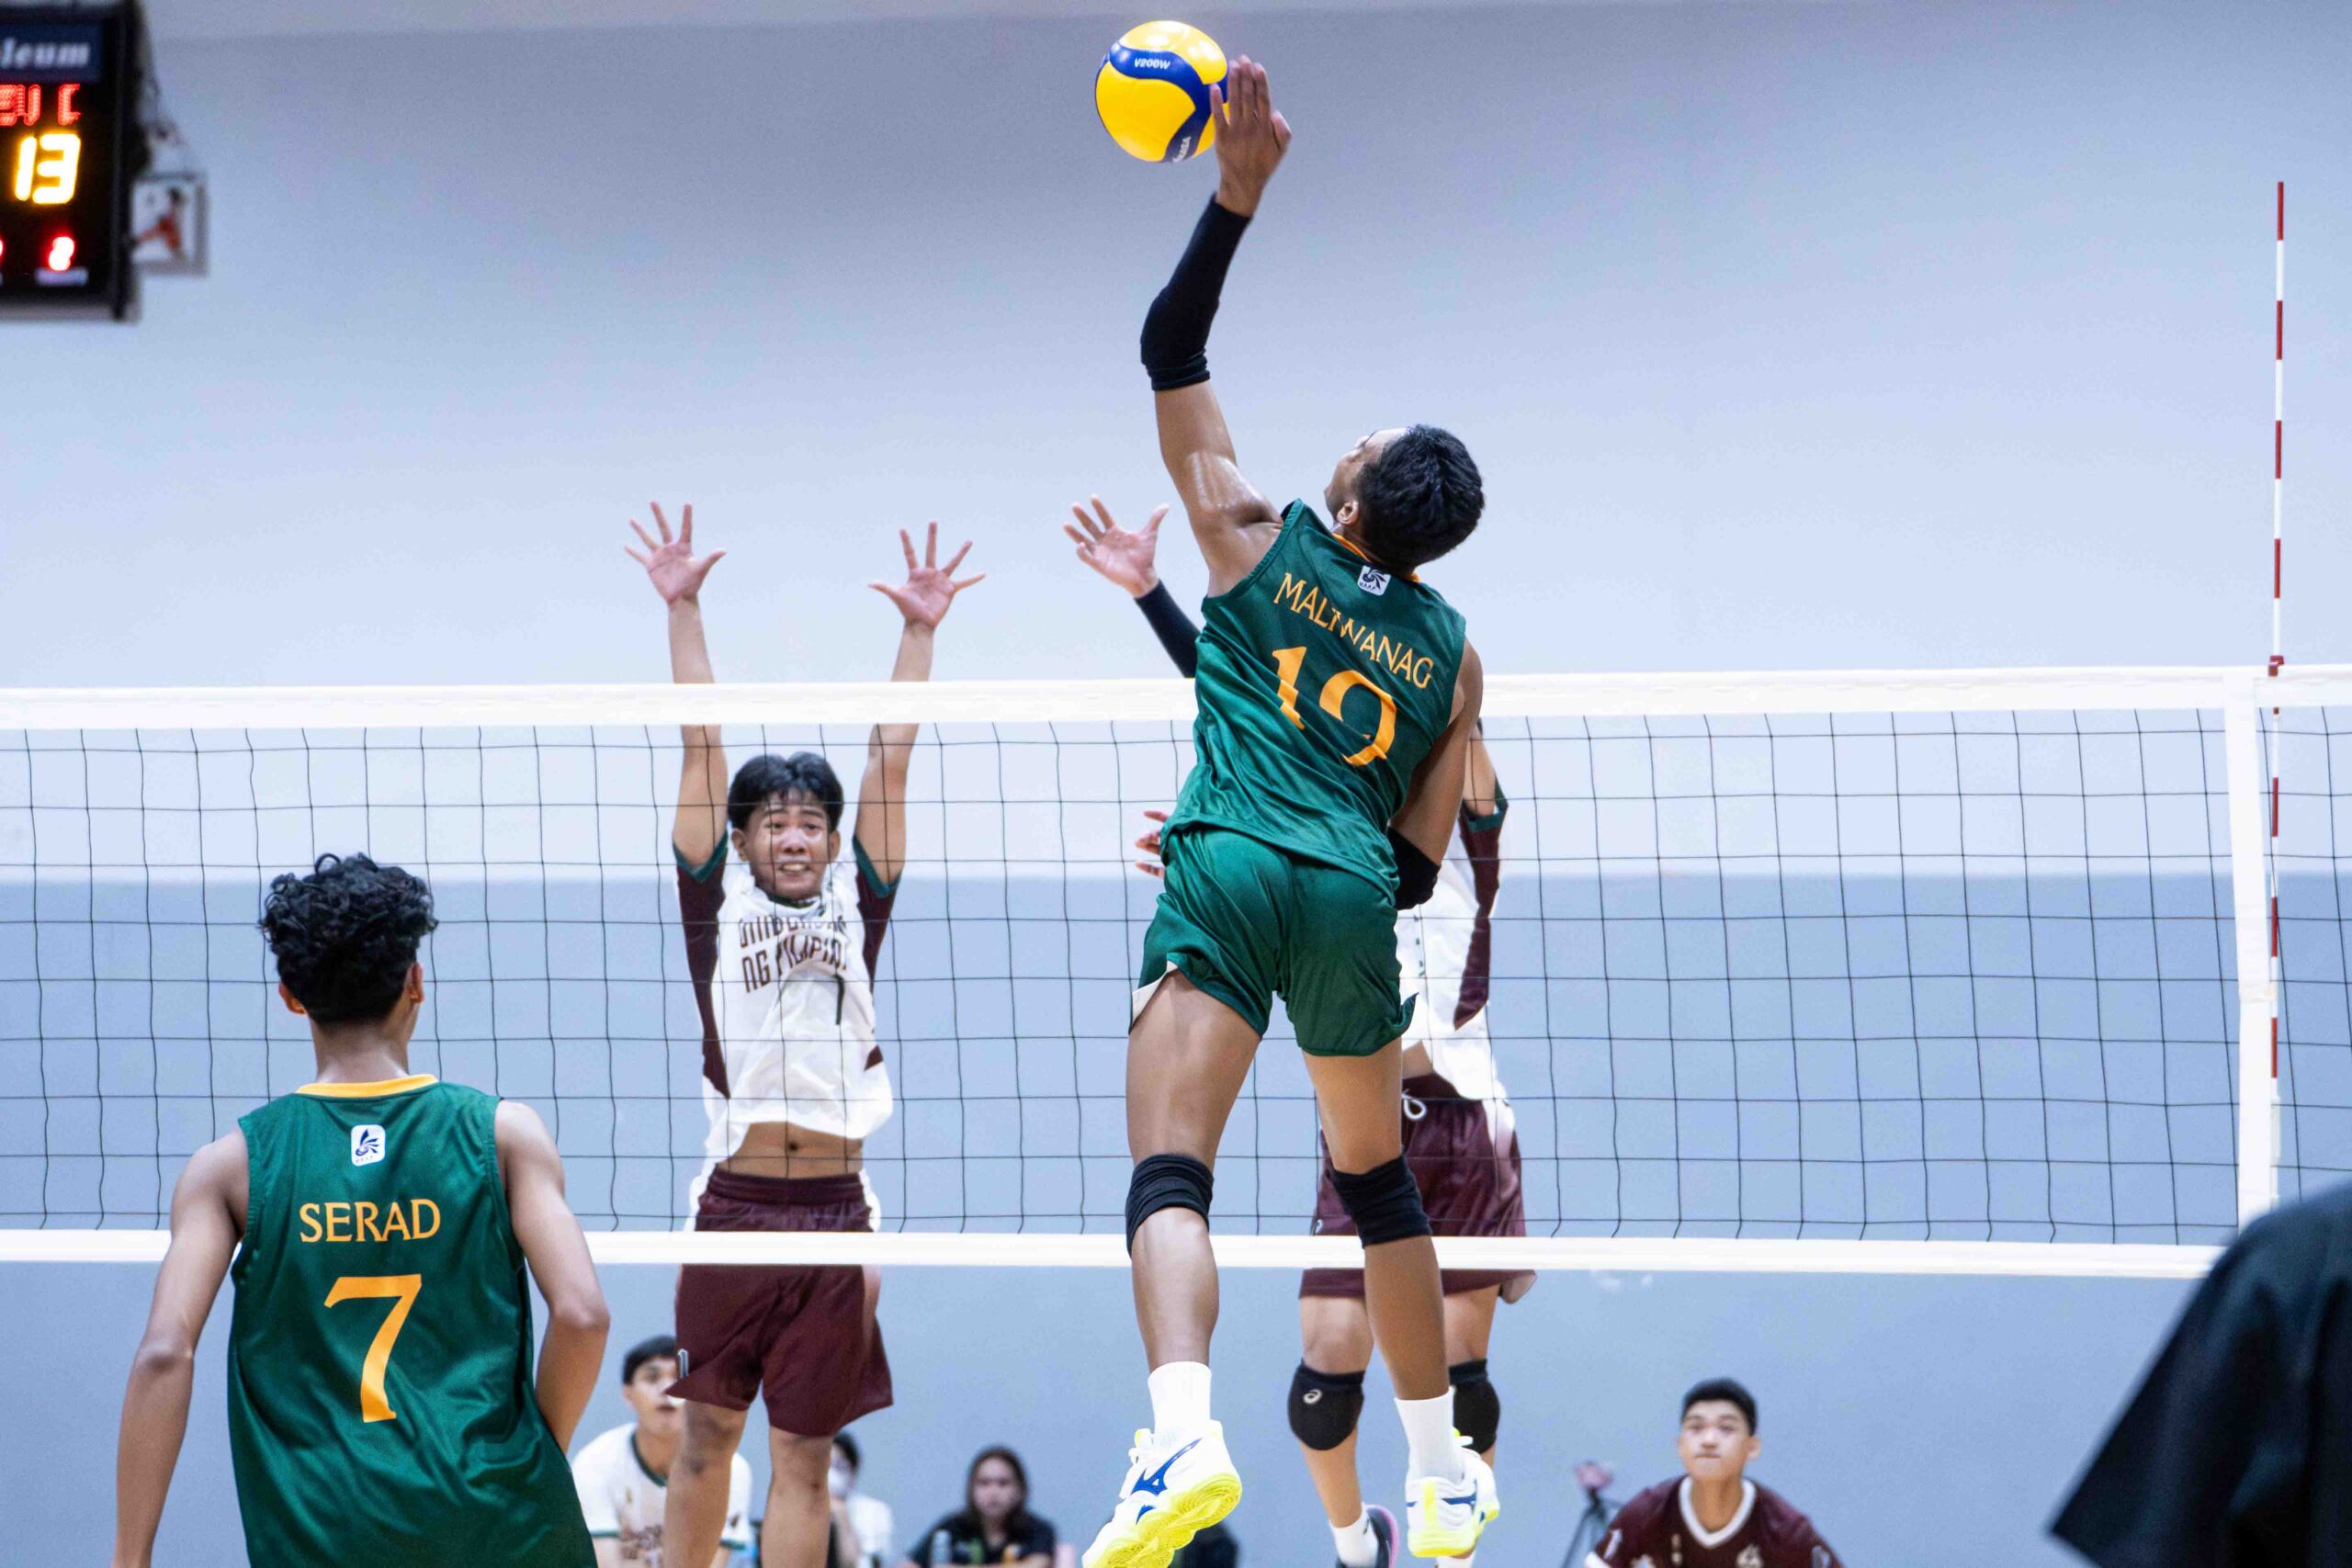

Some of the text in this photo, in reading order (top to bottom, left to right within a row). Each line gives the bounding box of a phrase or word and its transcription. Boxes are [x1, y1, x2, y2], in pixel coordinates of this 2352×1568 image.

[1134, 57, 1170, 70] V200W
[14, 133, 81, 205] 13
[299, 1199, 441, 1243] SERAD
[323, 1273, 423, 1424] 7
